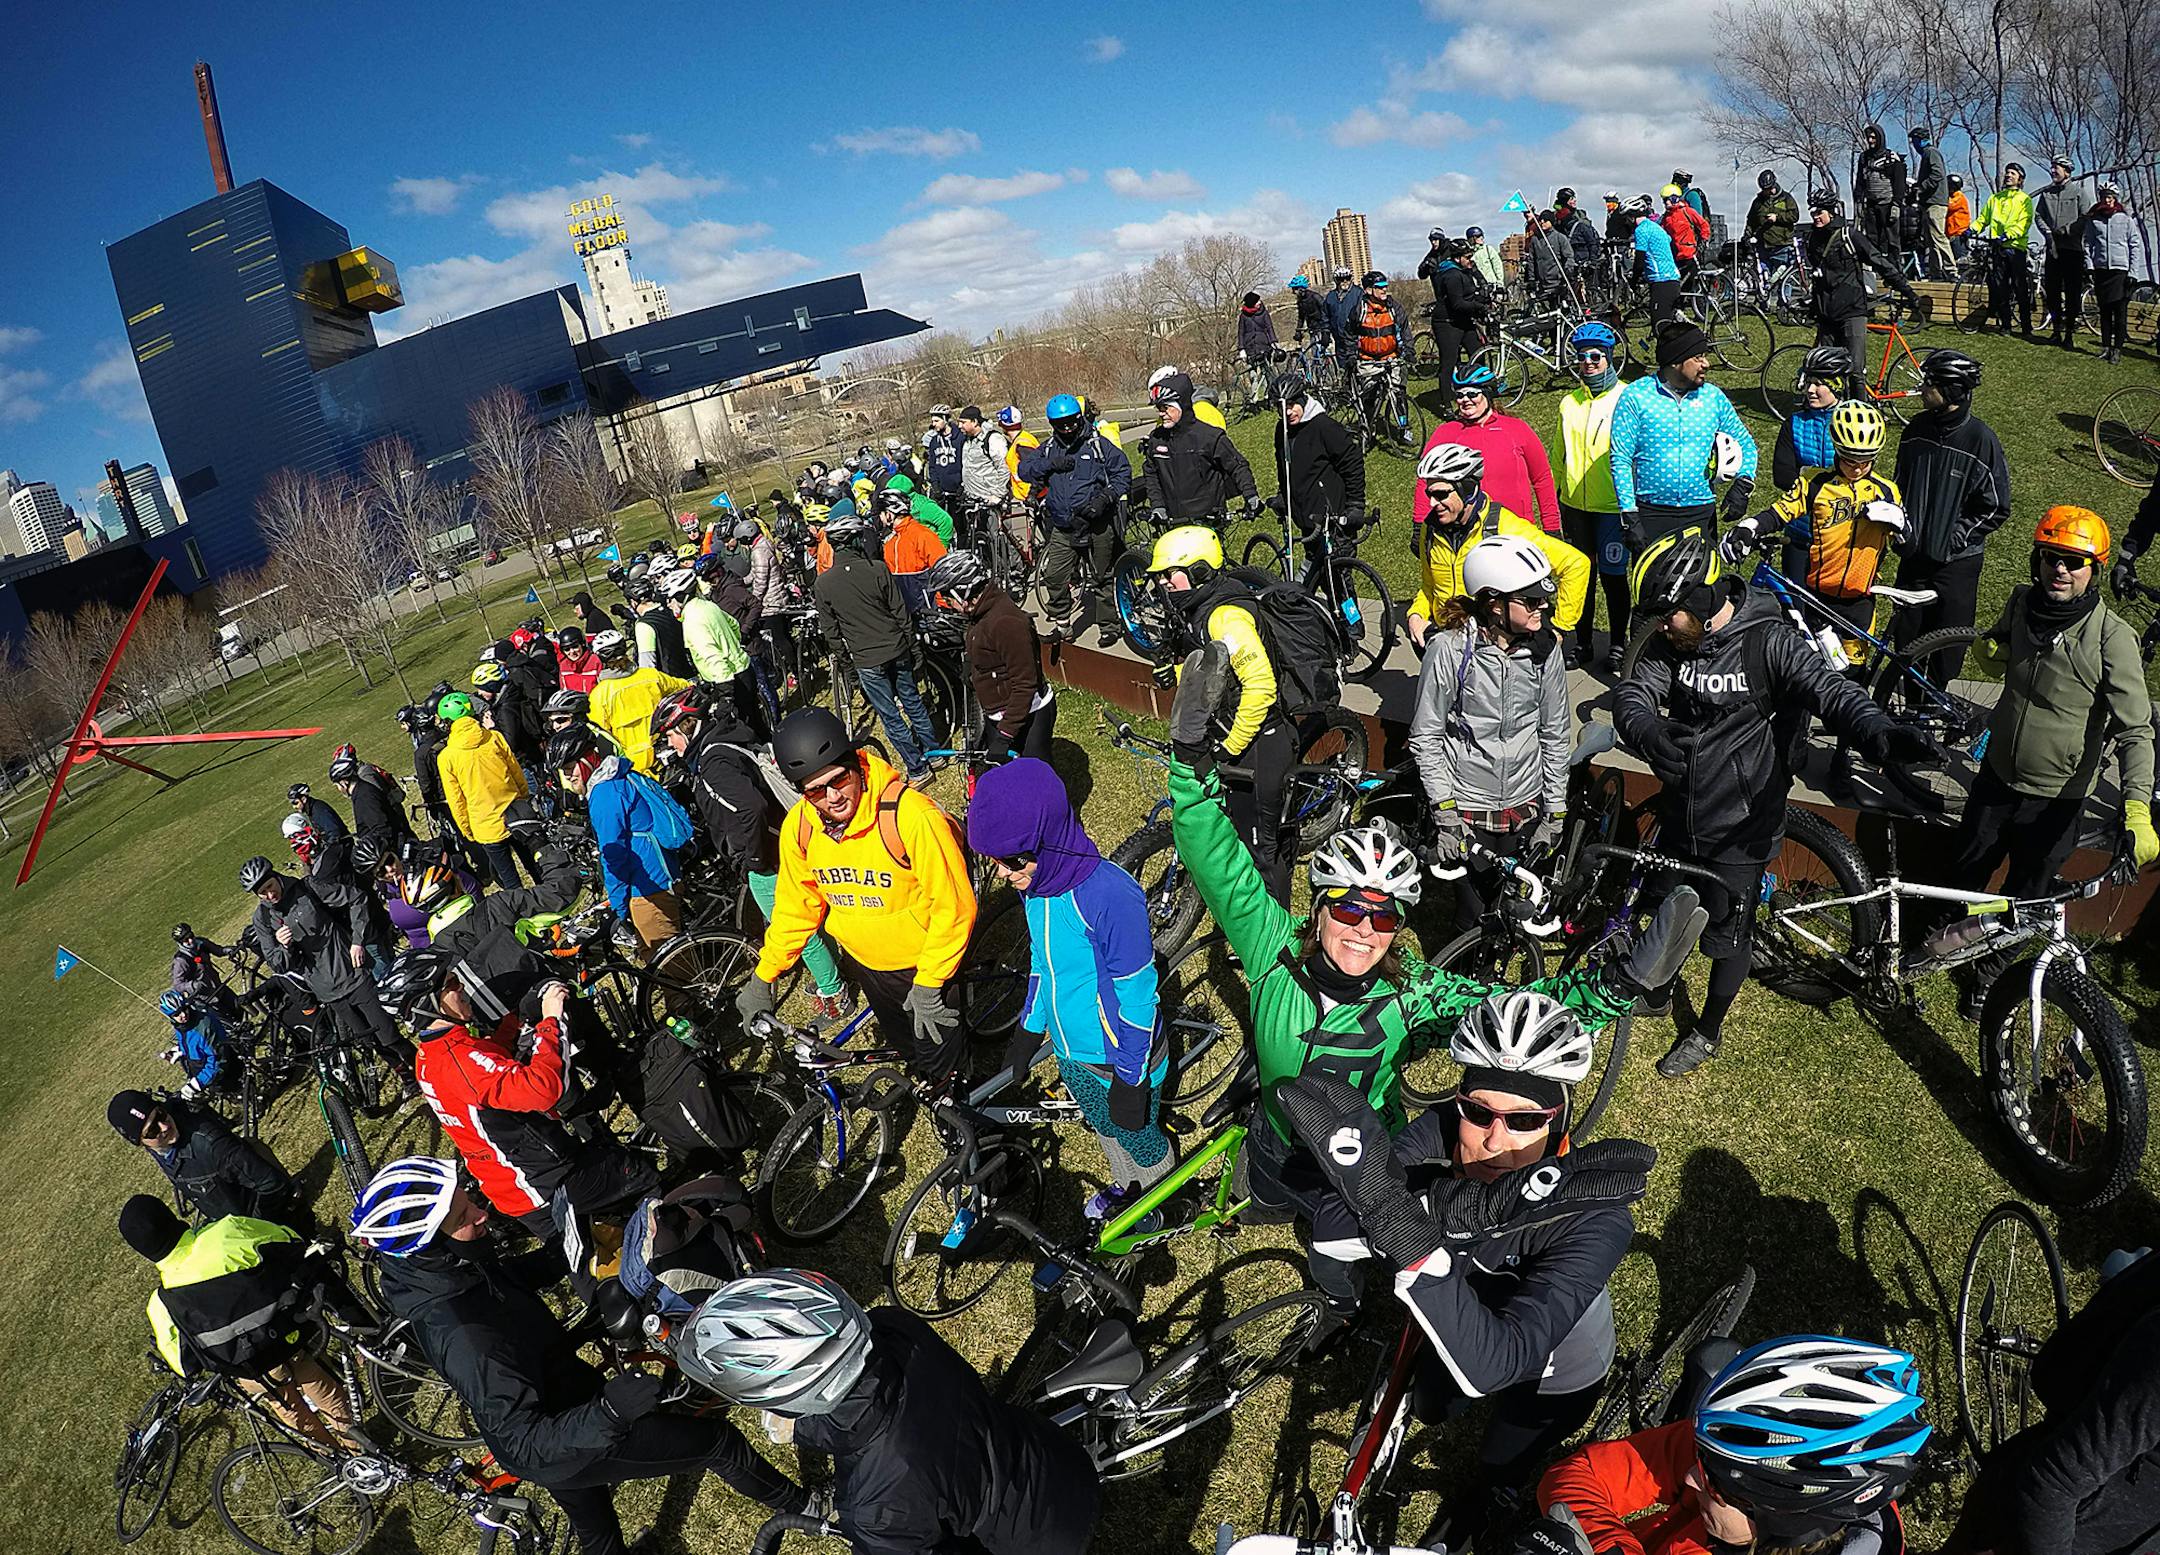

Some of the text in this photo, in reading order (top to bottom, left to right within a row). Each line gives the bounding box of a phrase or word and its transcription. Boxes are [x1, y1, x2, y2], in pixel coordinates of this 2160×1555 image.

[570, 194, 613, 216] GOLD
[568, 213, 624, 236] MEDAL
[573, 229, 628, 254] FLOUR
[860, 895, 884, 908] 1961
[1502, 1058, 1519, 1066] BELL
[1532, 1530, 1569, 1555] CRAFT
